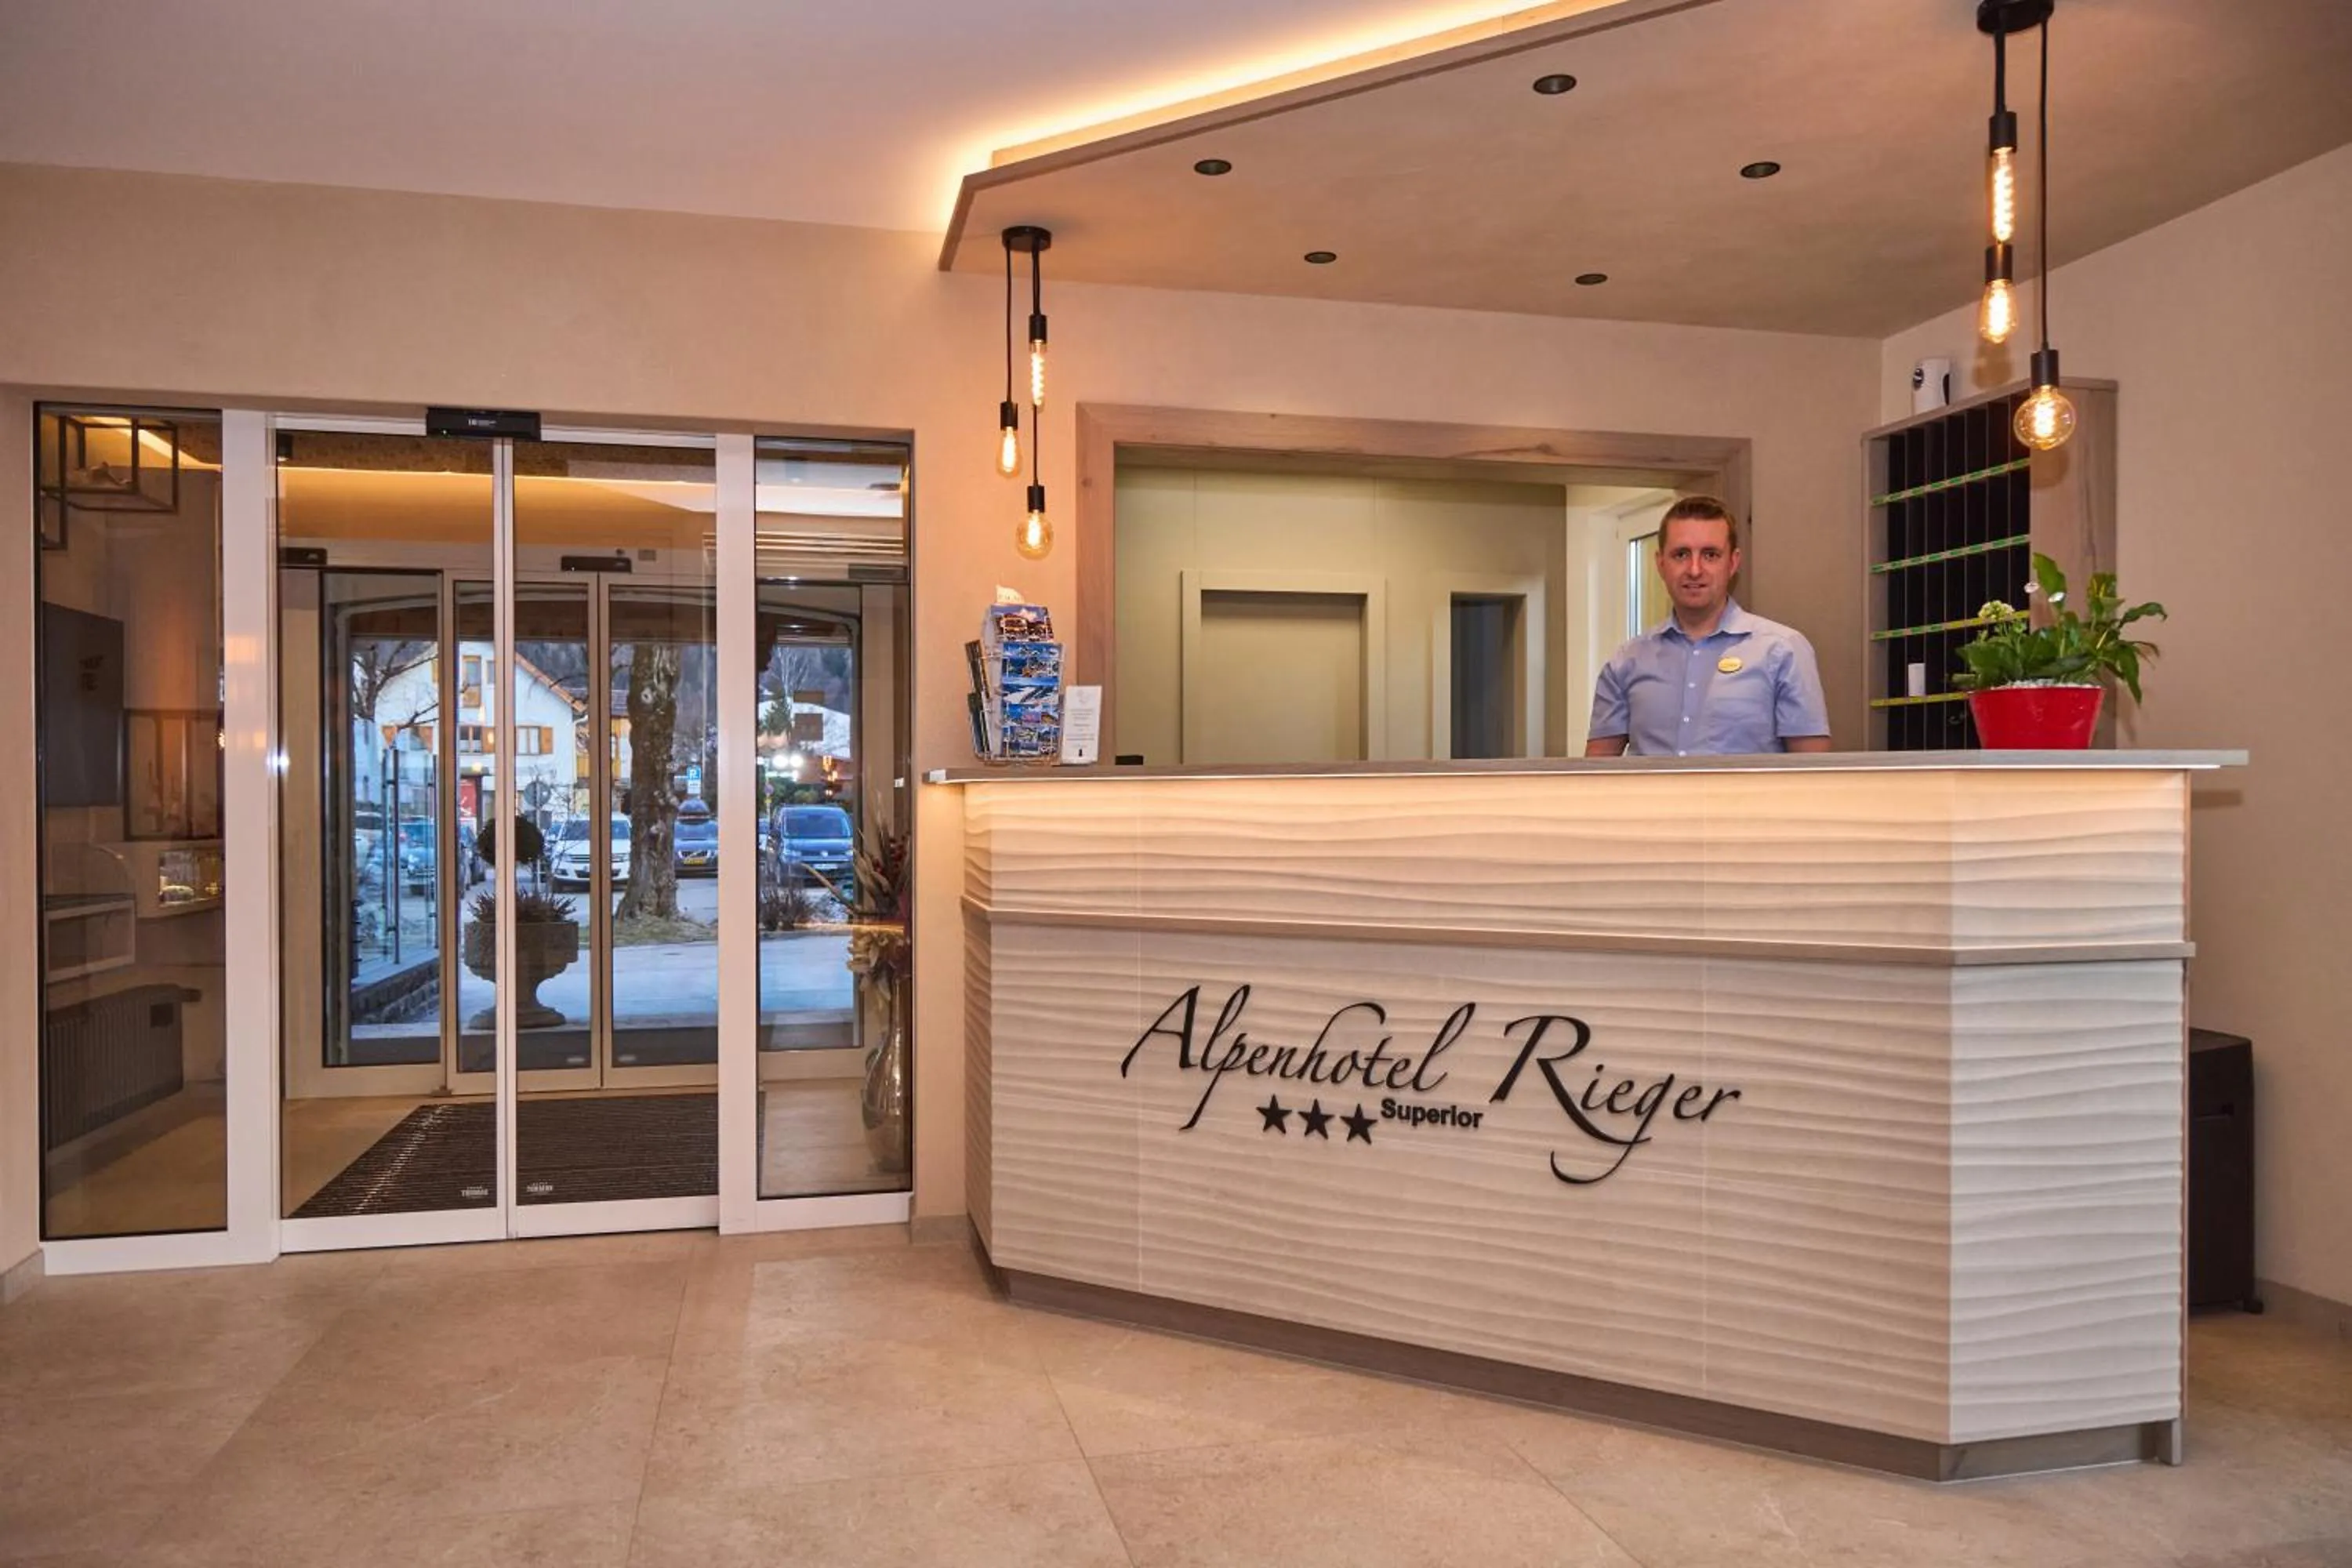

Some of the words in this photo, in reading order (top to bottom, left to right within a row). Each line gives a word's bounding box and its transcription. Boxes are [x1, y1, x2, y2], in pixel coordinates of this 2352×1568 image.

[1120, 985, 1476, 1131] Alpenhotel
[1489, 1015, 1742, 1185] Rieger
[1380, 1098, 1484, 1129] Superior
